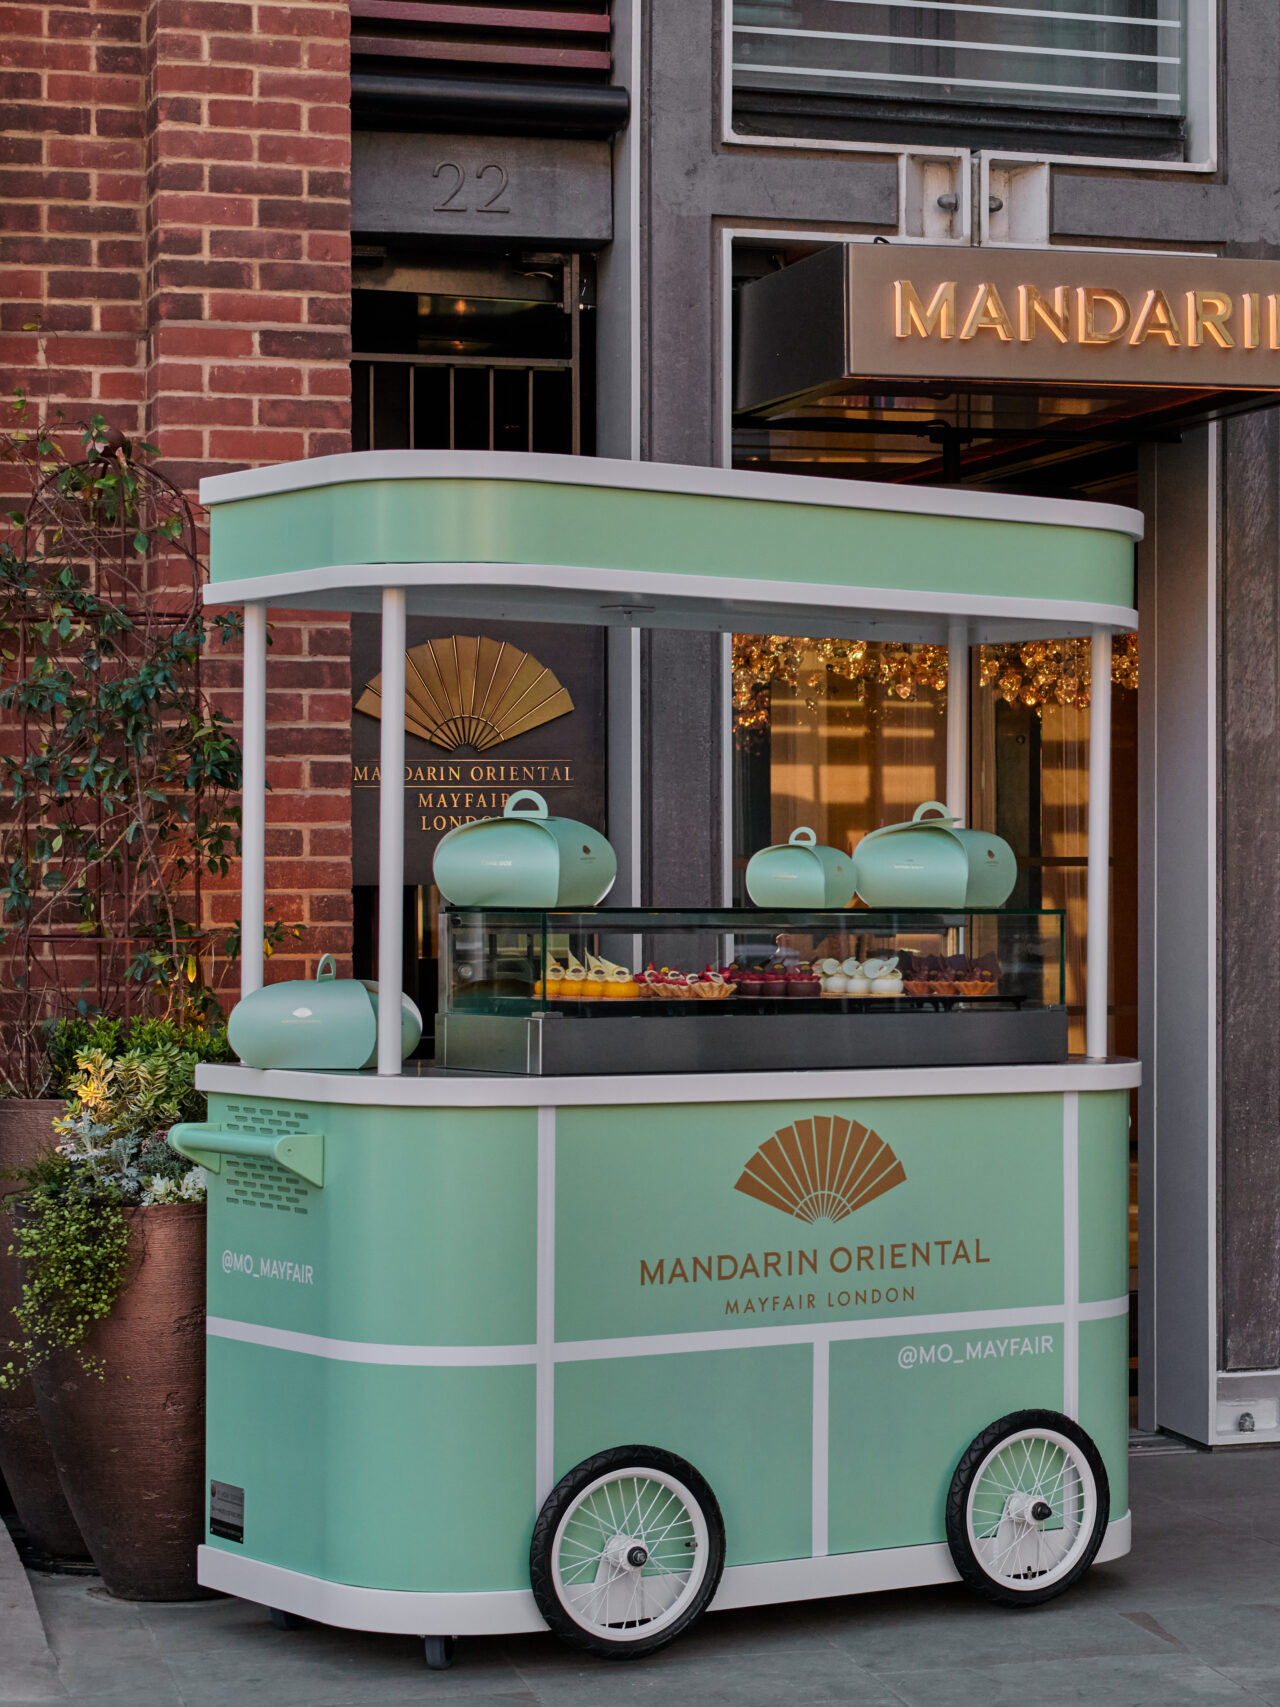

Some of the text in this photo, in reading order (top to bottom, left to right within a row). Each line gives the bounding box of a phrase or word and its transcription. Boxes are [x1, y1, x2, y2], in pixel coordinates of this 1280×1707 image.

[432, 162, 510, 214] 22
[353, 766, 575, 781] MADARIN ORIENTAL
[222, 1249, 314, 1285] @MO_MAYFAIR
[640, 1238, 991, 1286] MANDARIN ORIENTAL
[725, 1286, 916, 1315] MAYFAIR LONDON
[898, 1335, 1054, 1369] @MO_MAYFAIR
